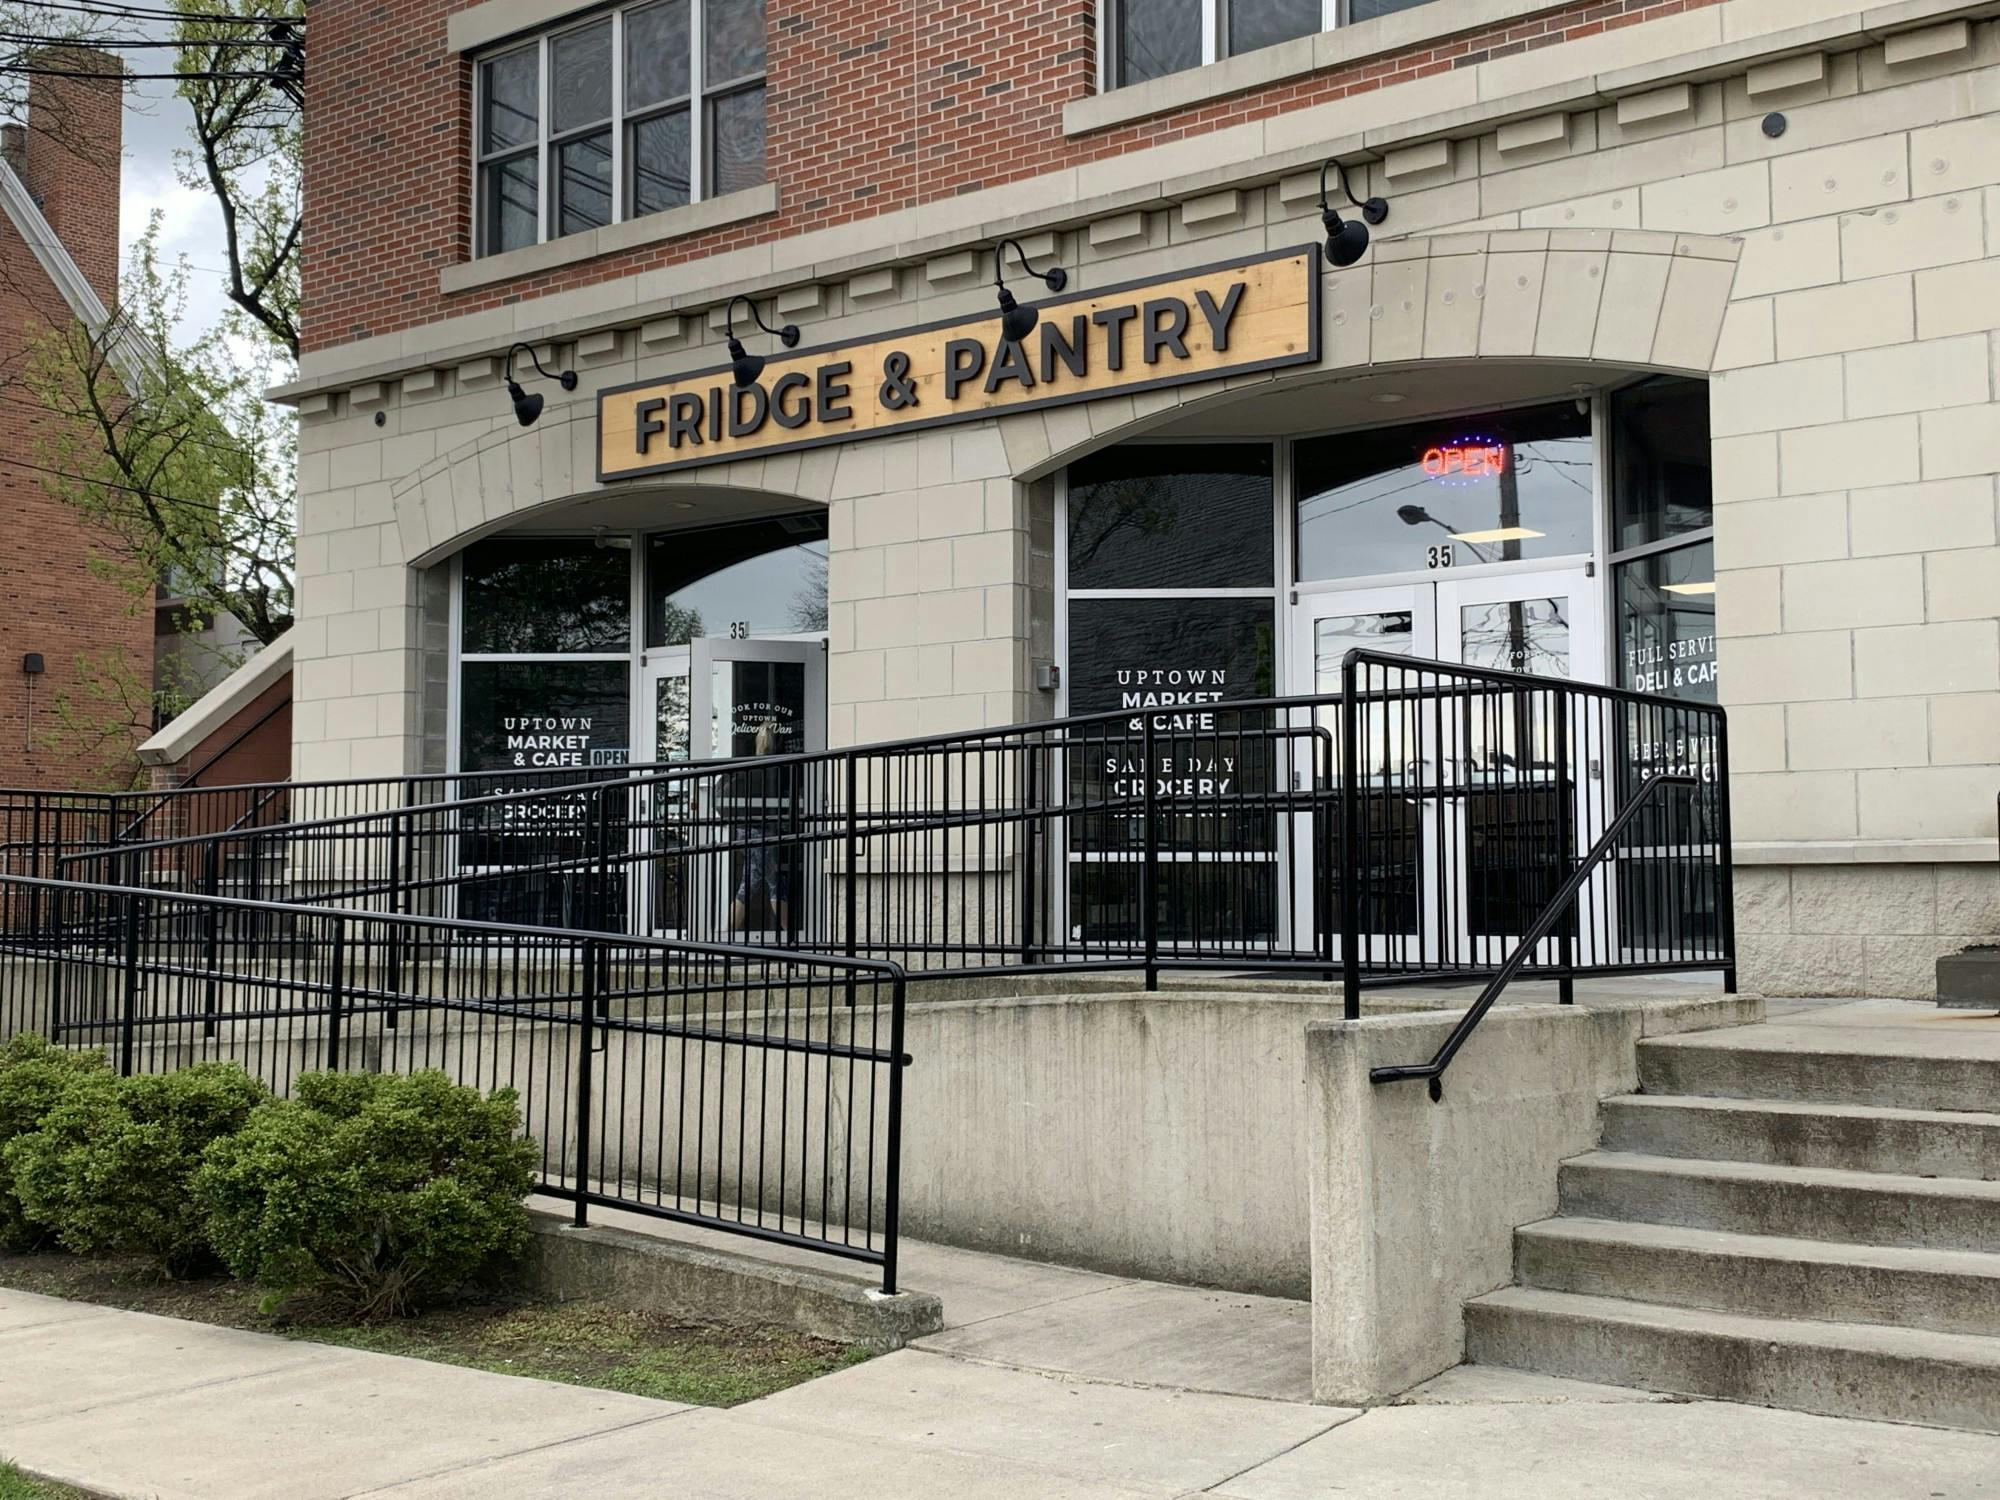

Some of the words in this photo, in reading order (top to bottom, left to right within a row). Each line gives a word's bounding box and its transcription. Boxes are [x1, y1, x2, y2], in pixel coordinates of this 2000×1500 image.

[636, 361, 853, 454] FRIDGE
[879, 351, 919, 408] &
[945, 282, 1246, 399] PANTRY
[1422, 447, 1504, 474] OPEN
[1428, 546, 1452, 569] 35
[730, 621, 745, 639] 35
[1629, 646, 1663, 667] FULL
[1669, 636, 1714, 660] SERVI
[1117, 670, 1226, 685] UPTOWN
[1635, 670, 1668, 692] DELI
[1673, 667, 1683, 687] &
[1687, 661, 1718, 684] CAF
[1122, 692, 1223, 709] MARKET
[731, 704, 750, 713] OOK
[753, 702, 771, 710] FOR
[774, 704, 793, 717] OUR
[504, 717, 592, 730] UPTOWN
[768, 722, 793, 734] Van
[1128, 718, 1143, 731] &
[1153, 713, 1214, 730] CAFE
[507, 735, 590, 749] MARKET
[513, 752, 526, 766] &
[532, 752, 582, 766] CAFE
[593, 750, 629, 766] OPEN
